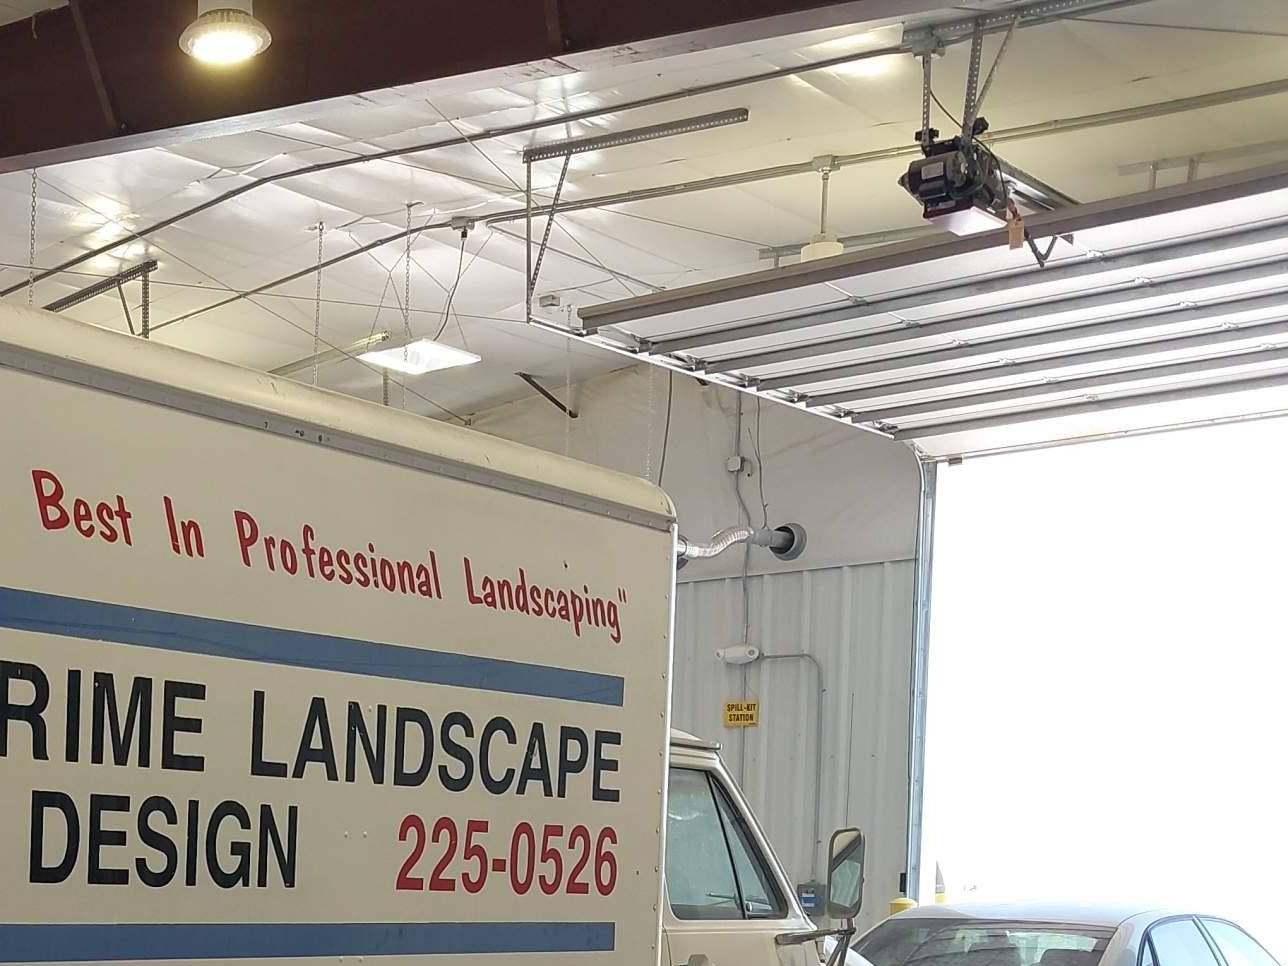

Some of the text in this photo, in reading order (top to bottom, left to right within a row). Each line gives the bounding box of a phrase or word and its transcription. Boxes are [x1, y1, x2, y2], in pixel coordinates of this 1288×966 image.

[31, 469, 133, 547] Best
[162, 495, 205, 558] In
[233, 509, 443, 600] Professional
[463, 557, 627, 644] Landscaping"
[250, 690, 622, 803] LANDSCAPE
[726, 703, 757, 722] SPILL-KIT STATION
[29, 789, 299, 889] DESIGN
[396, 814, 617, 896] 225-0526
